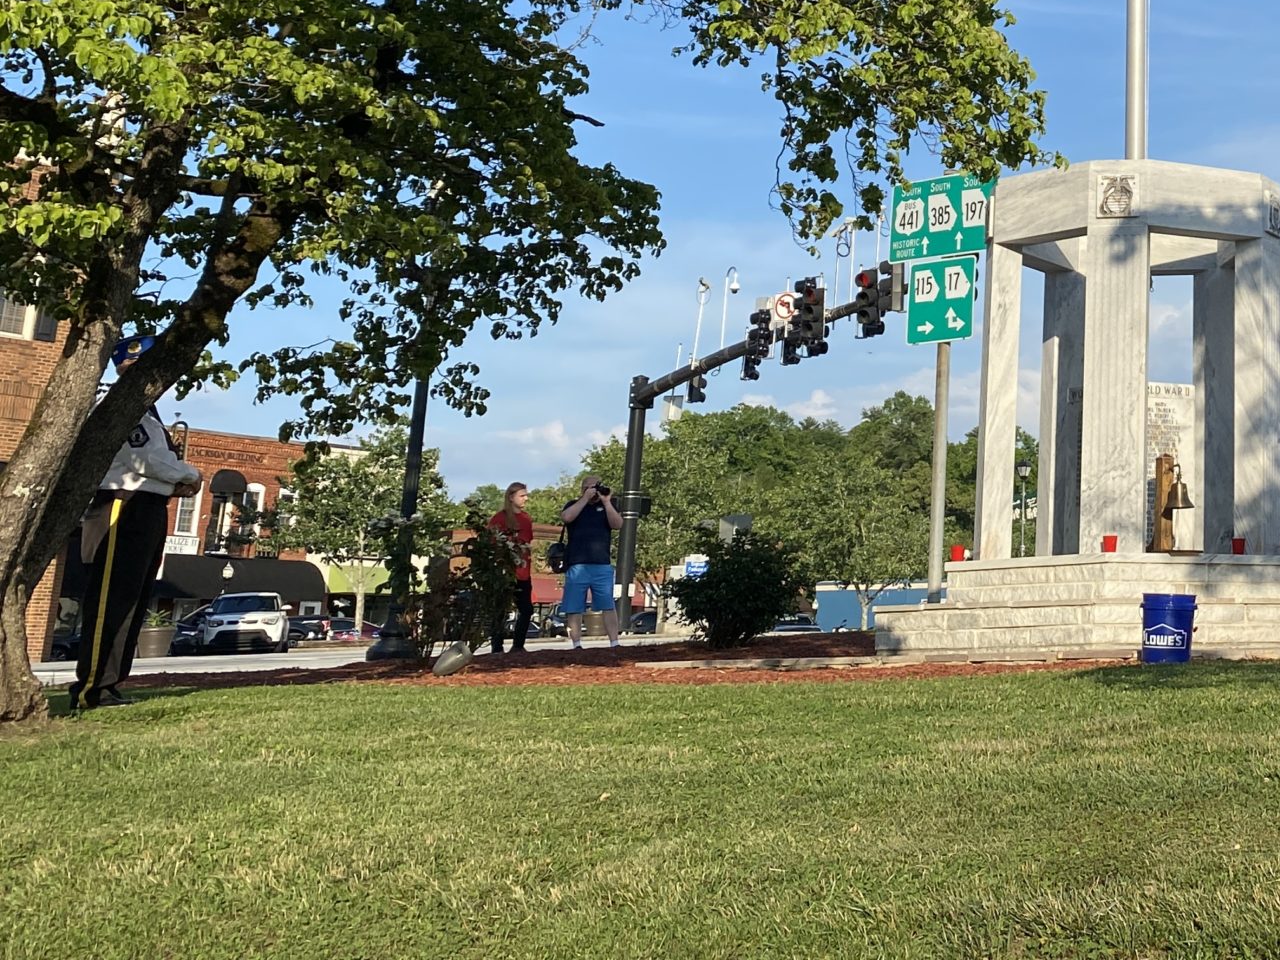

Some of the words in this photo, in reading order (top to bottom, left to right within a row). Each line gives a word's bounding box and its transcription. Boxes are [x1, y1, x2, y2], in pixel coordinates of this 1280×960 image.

[930, 182, 950, 192] SOUTH
[963, 177, 981, 187] SOU
[904, 202, 916, 210] BUS
[965, 201, 984, 221] 197
[899, 210, 919, 230] 441
[931, 205, 950, 226] 385
[893, 238, 920, 249] HISTORIC
[896, 248, 915, 258] ROUTE
[916, 276, 933, 295] 115
[948, 272, 960, 291] 17
[1163, 386, 1183, 396] WAR
[1144, 632, 1182, 646] LOWE'S
